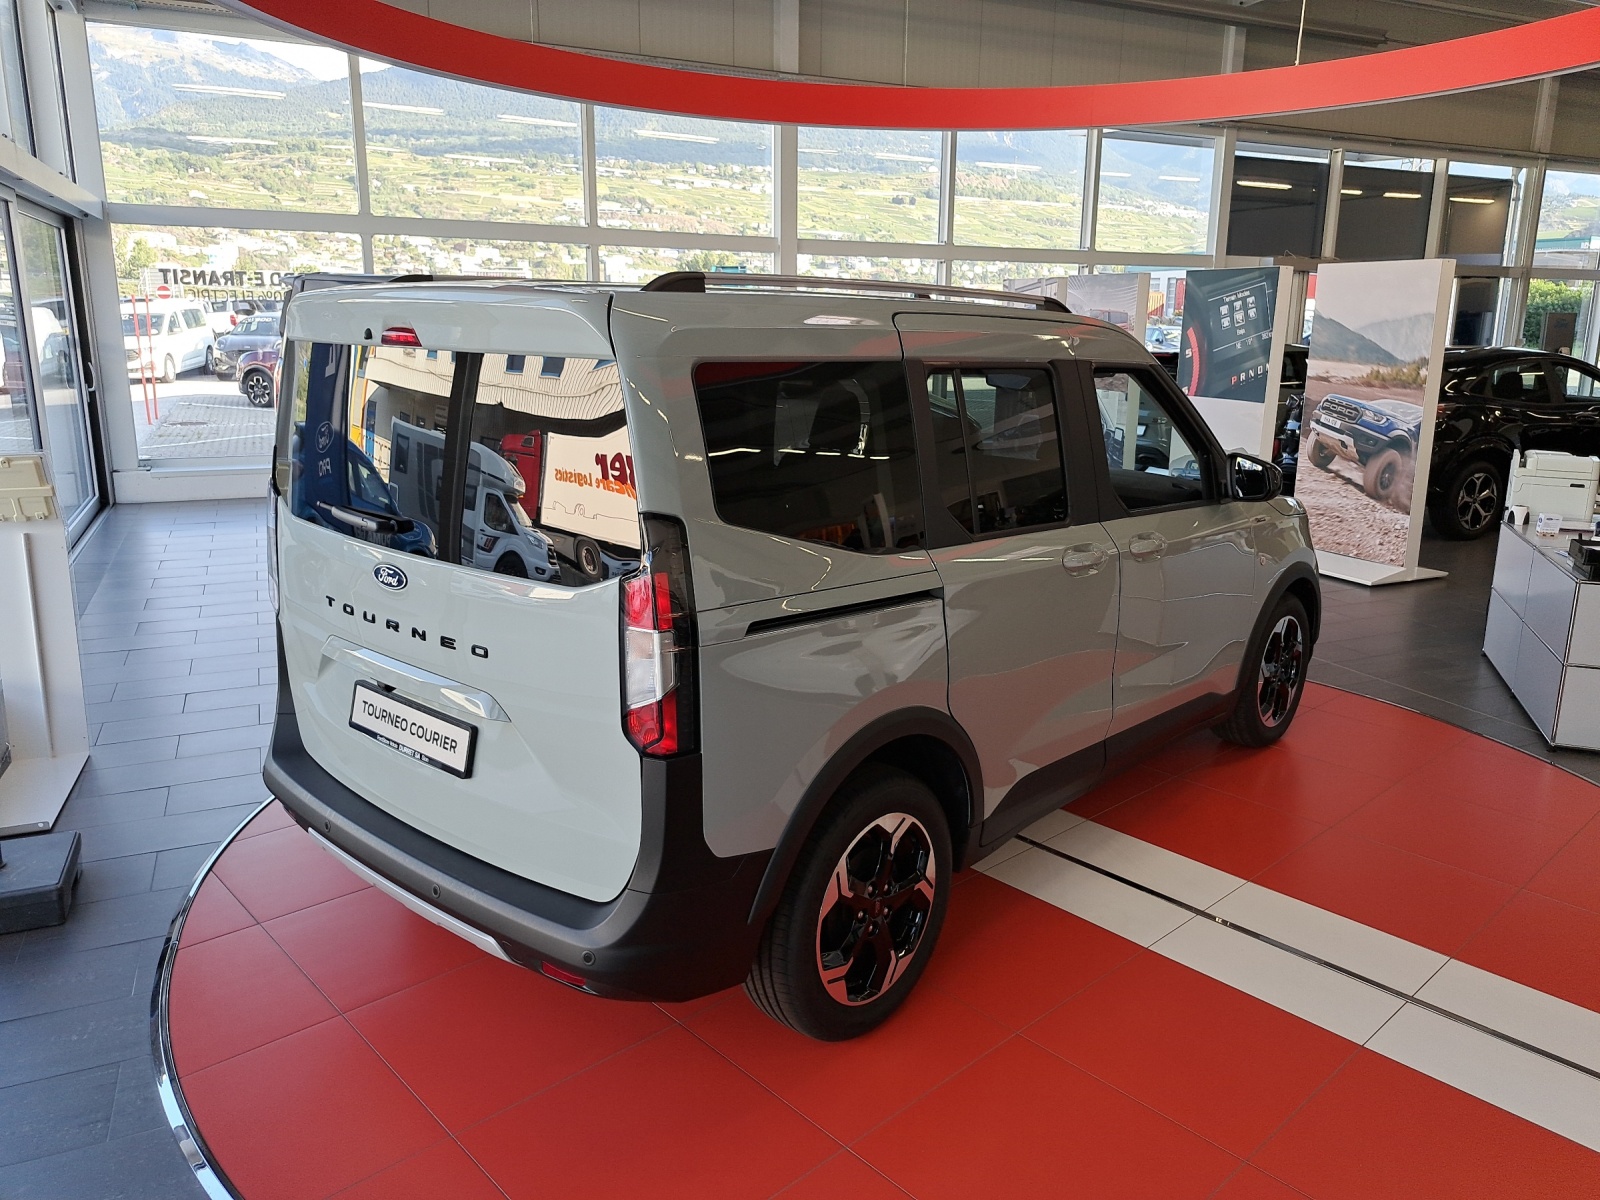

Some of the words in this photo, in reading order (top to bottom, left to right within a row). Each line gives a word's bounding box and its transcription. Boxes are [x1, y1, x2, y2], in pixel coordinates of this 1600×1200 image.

[1323, 401, 1357, 416] FORD
[377, 566, 400, 587] Ford
[325, 595, 490, 660] TOURNEO
[362, 700, 408, 732] TOURNEO
[409, 721, 458, 754] COURIER
